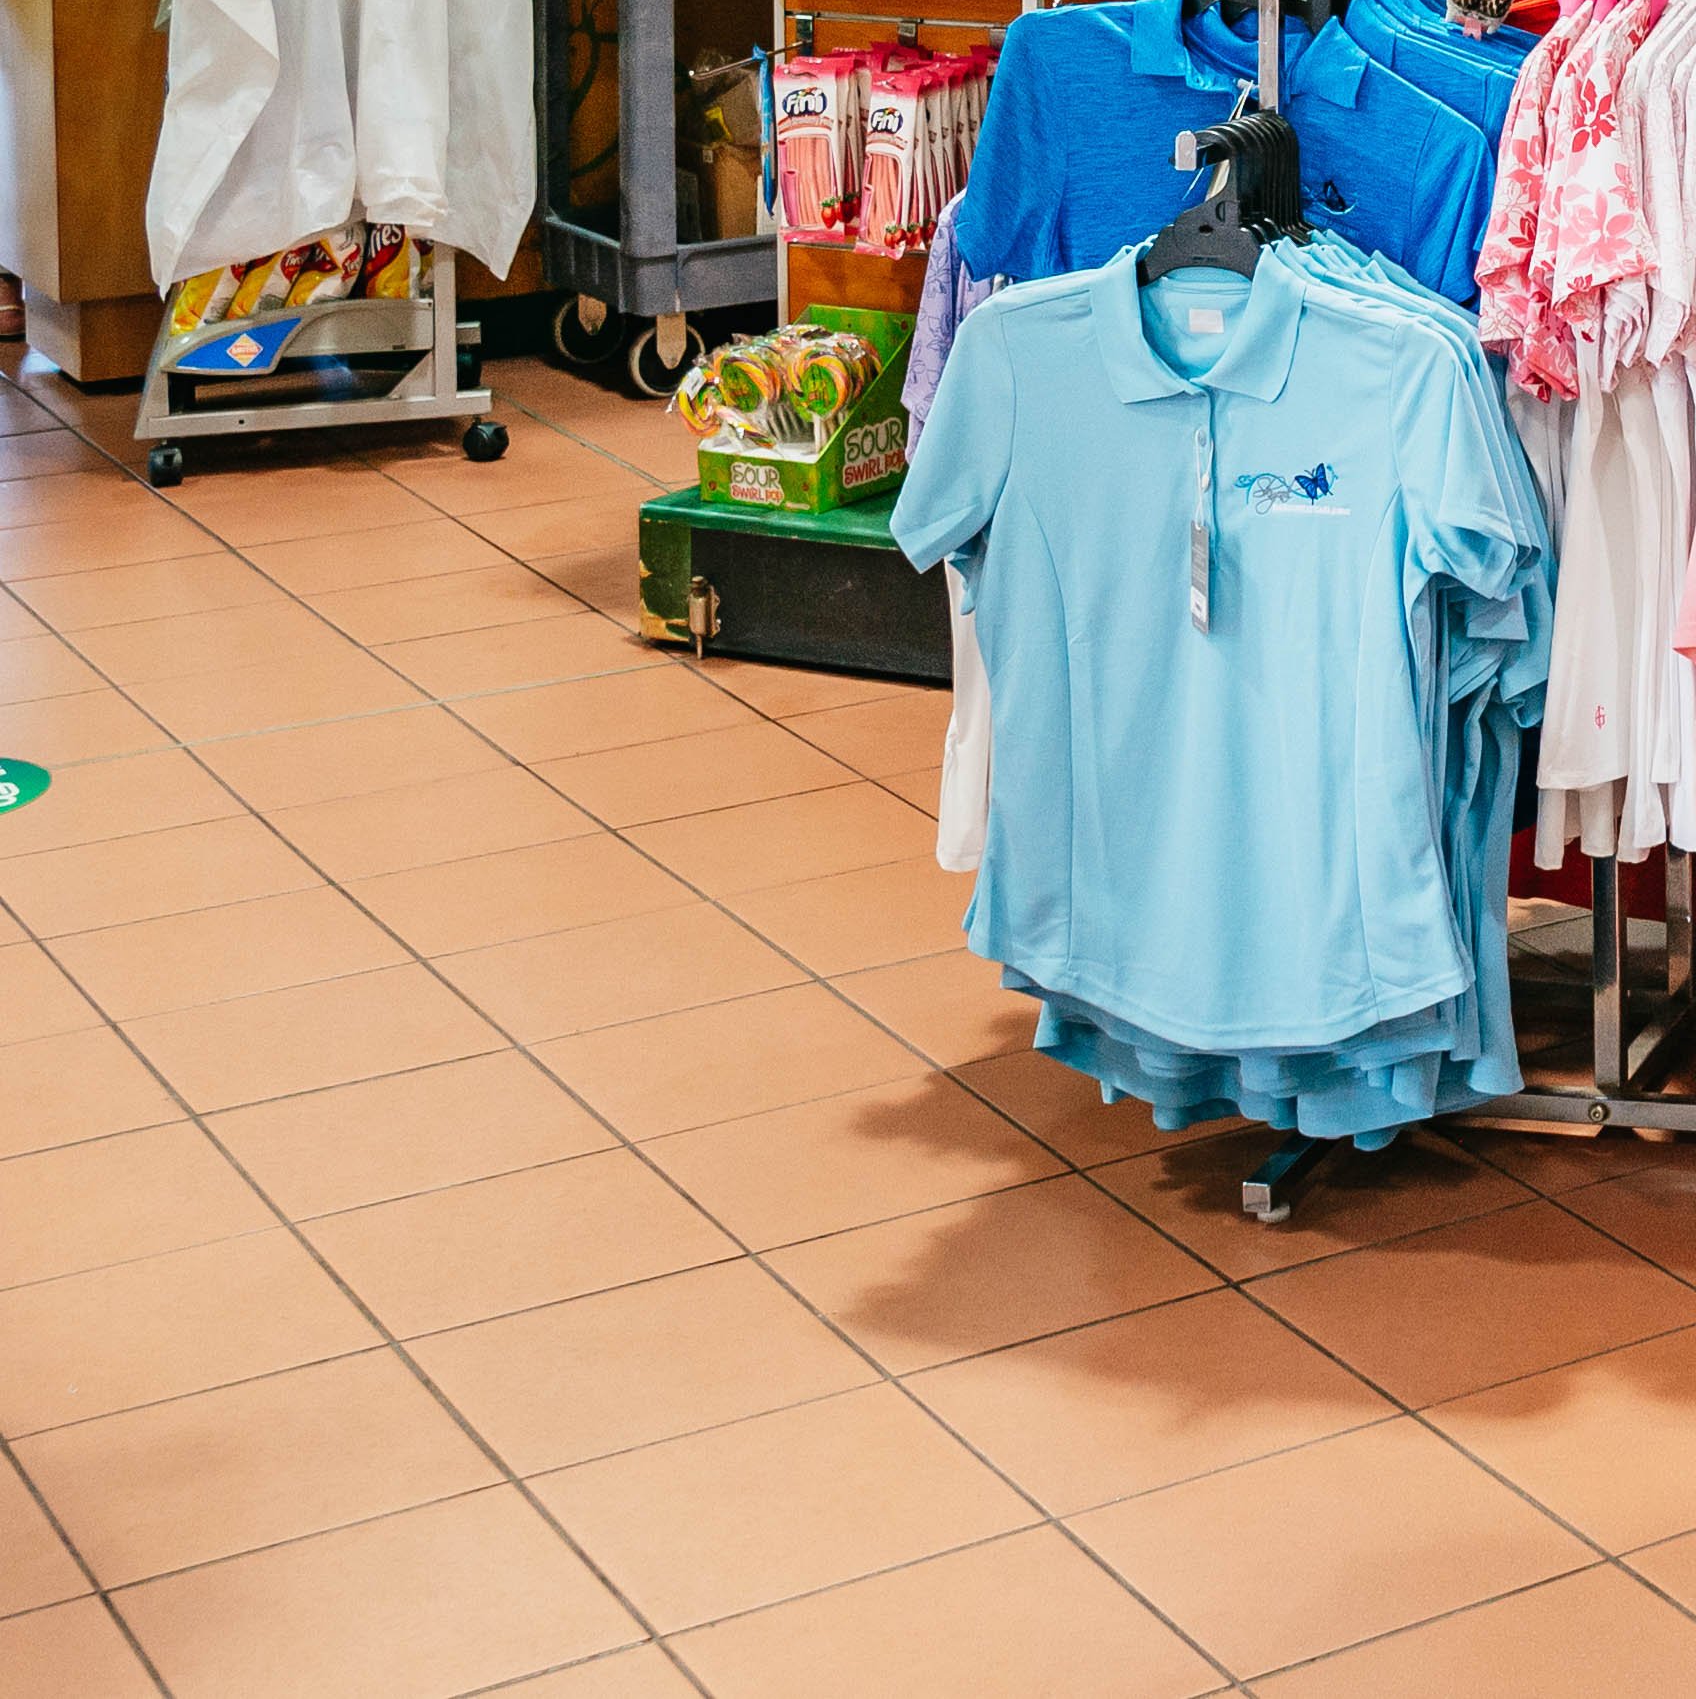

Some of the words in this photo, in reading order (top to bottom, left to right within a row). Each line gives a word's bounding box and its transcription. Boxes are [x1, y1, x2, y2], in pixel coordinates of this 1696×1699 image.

[785, 88, 824, 115] Fini
[872, 109, 900, 133] Fini
[846, 420, 902, 462] SOUR
[732, 464, 780, 489] SOUR
[844, 460, 883, 486] SWIRL
[732, 484, 764, 501] SWIRL
